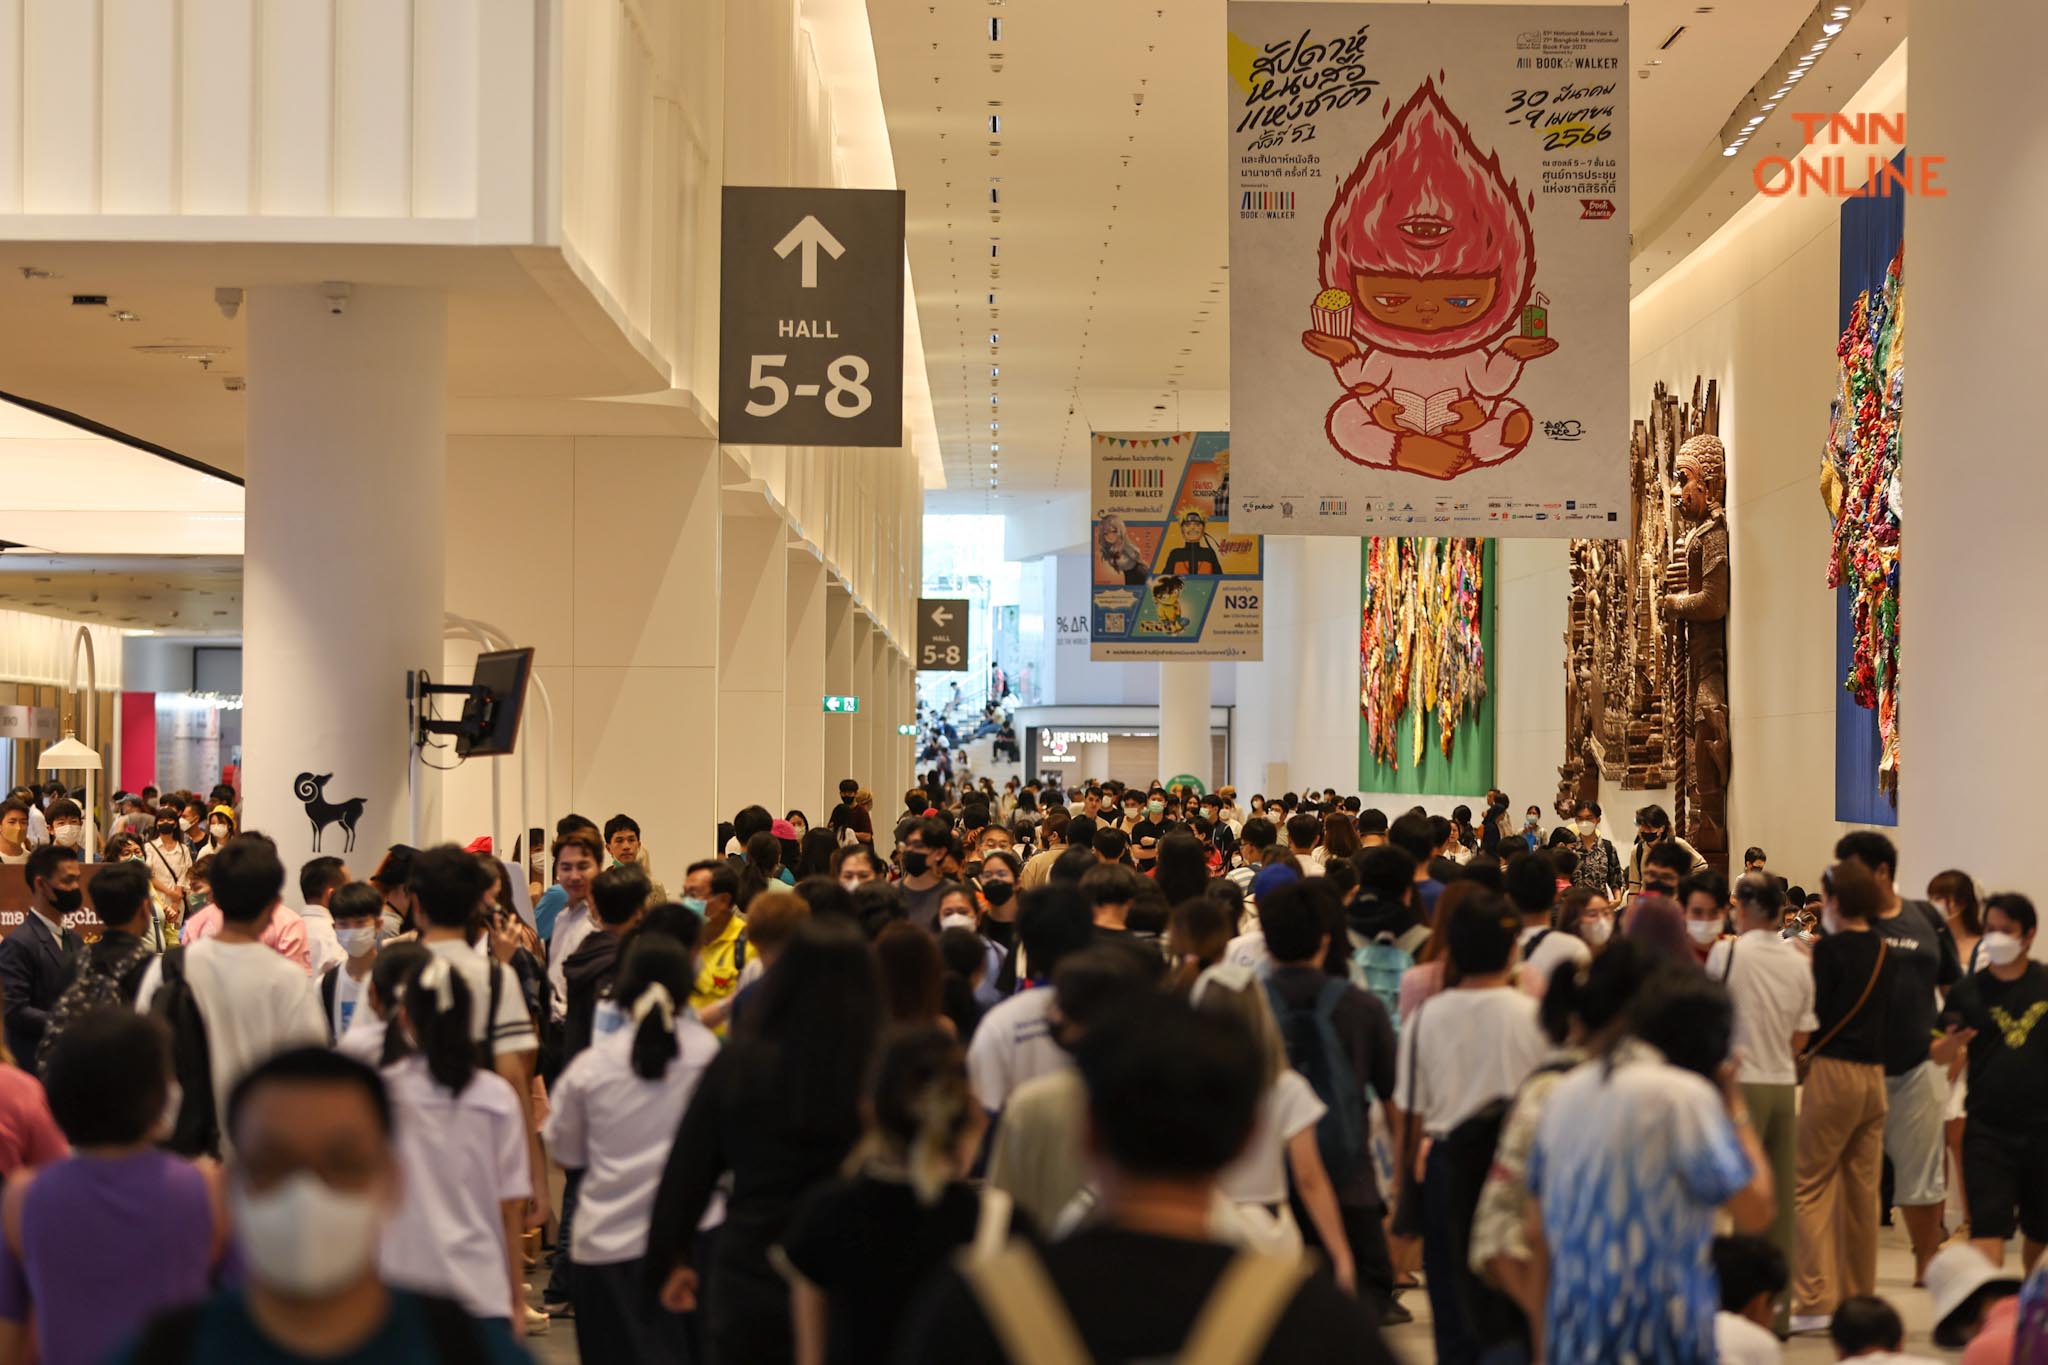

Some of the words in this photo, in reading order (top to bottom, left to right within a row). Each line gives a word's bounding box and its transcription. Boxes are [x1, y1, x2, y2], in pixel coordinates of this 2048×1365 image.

[1249, 25, 1370, 83] สัปดาห์
[1536, 57, 1563, 69] BOOK
[1575, 57, 1619, 69] WALKER
[1245, 53, 1366, 106] หนังสือ
[1236, 80, 1380, 133] แห่งชาติ
[1504, 88, 1549, 114] 30
[1552, 82, 1617, 104] มีนาคม
[1544, 105, 1616, 128] เมษายน
[1291, 123, 1317, 143] 51
[1542, 123, 1612, 151] 2566
[1241, 153, 1321, 164] และสัปดาห์หนังสือ
[1241, 167, 1282, 177] นานาชาติ
[1284, 164, 1308, 177] ครั้งที่
[1309, 169, 1322, 177] 21
[1542, 169, 1617, 184] ศูนย์การประชุม
[1240, 211, 1258, 219] BOOK
[1266, 211, 1295, 219] WALKER
[778, 319, 839, 338] HALL
[744, 354, 873, 418] 5-8
[1135, 489, 1164, 498] WALKER
[1225, 594, 1258, 609] N32
[932, 634, 951, 643] HALL
[923, 644, 961, 665] 5-8
